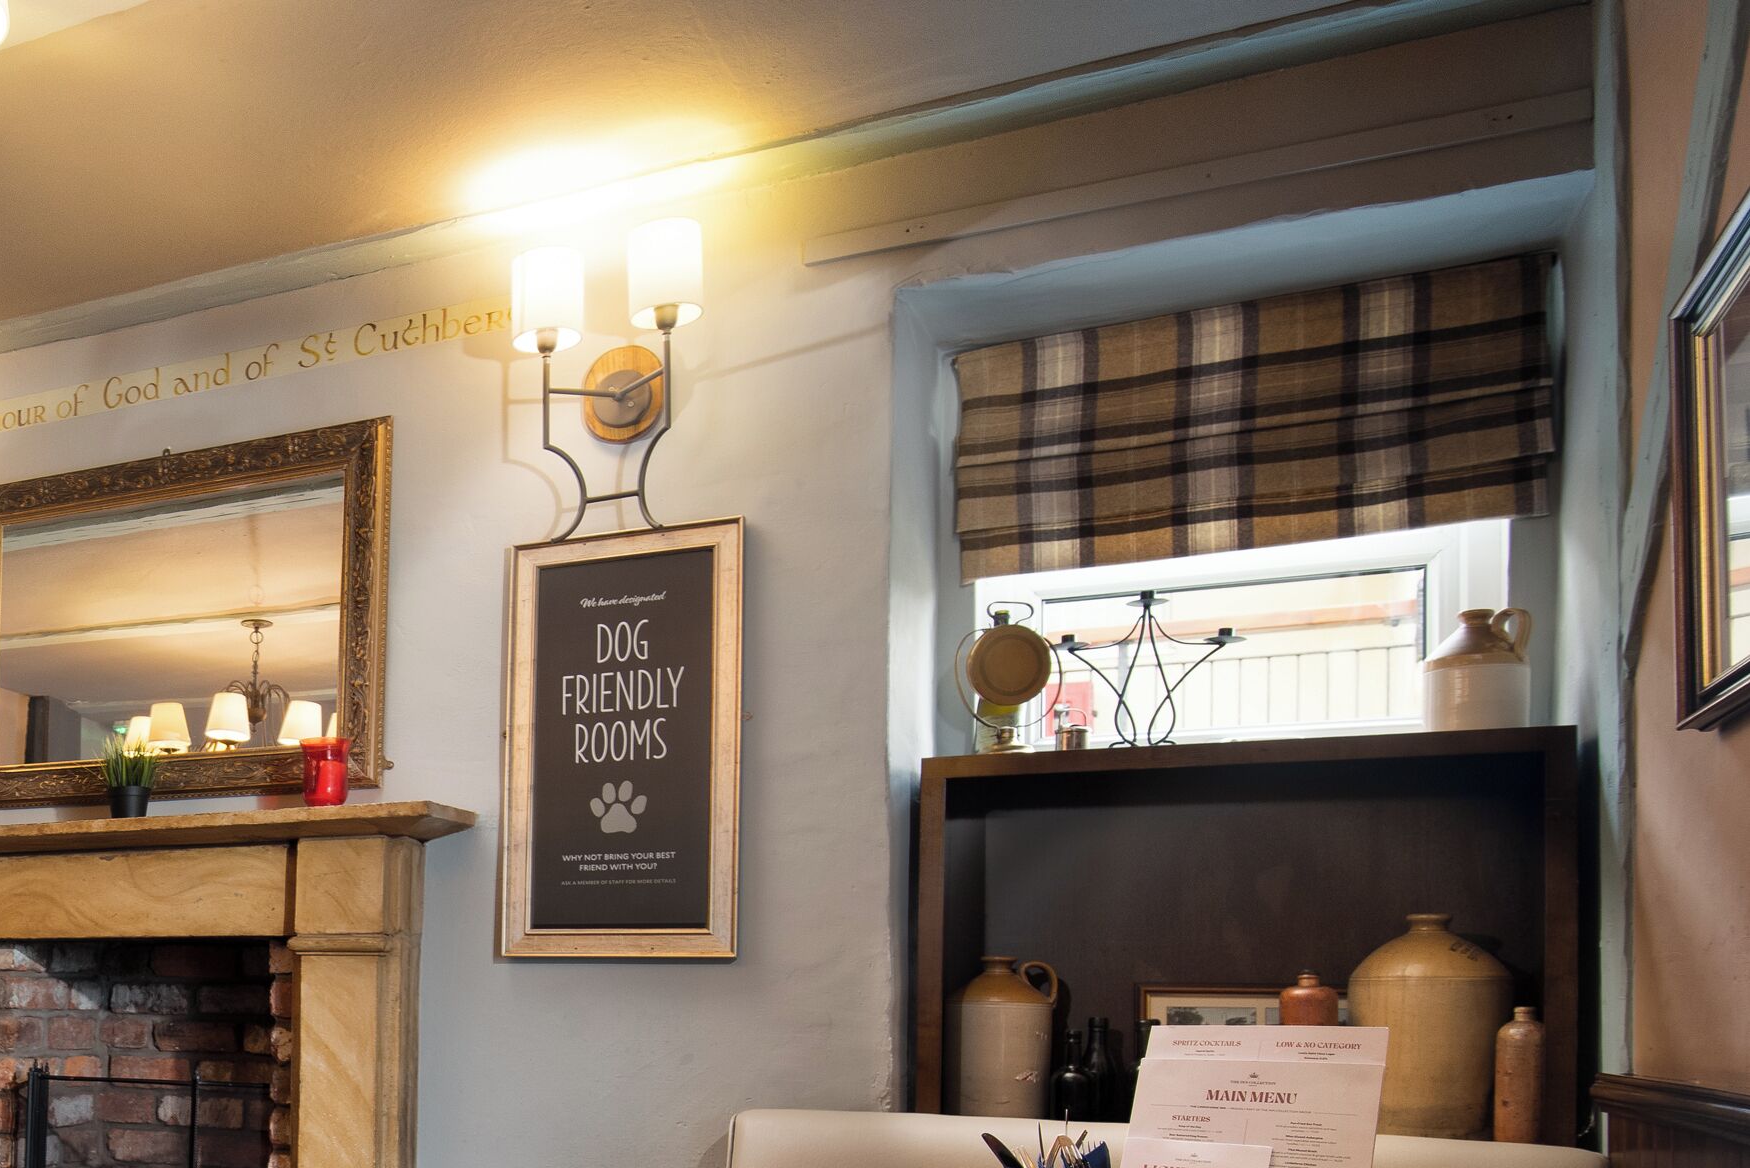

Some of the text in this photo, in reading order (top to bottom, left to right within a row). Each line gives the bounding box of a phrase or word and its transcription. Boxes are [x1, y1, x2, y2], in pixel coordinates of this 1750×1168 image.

[56, 383, 89, 418] of
[103, 367, 160, 409] God
[173, 353, 230, 396] and
[245, 343, 279, 381] of
[579, 591, 667, 608] We have designated
[596, 619, 650, 664] DOG
[562, 666, 685, 715] FRIENDLY
[575, 717, 668, 764] ROOMS
[562, 854, 583, 862] WHY
[604, 853, 629, 861] BRING
[630, 852, 654, 860] YOUR
[656, 851, 676, 859] BEST
[579, 864, 608, 872] FRIEND
[610, 863, 634, 871] WITH
[1317, 1042, 1362, 1050] CATEGORY
[1206, 1089, 1298, 1105] MAIN MENU
[1171, 1114, 1211, 1123] STARTERS
